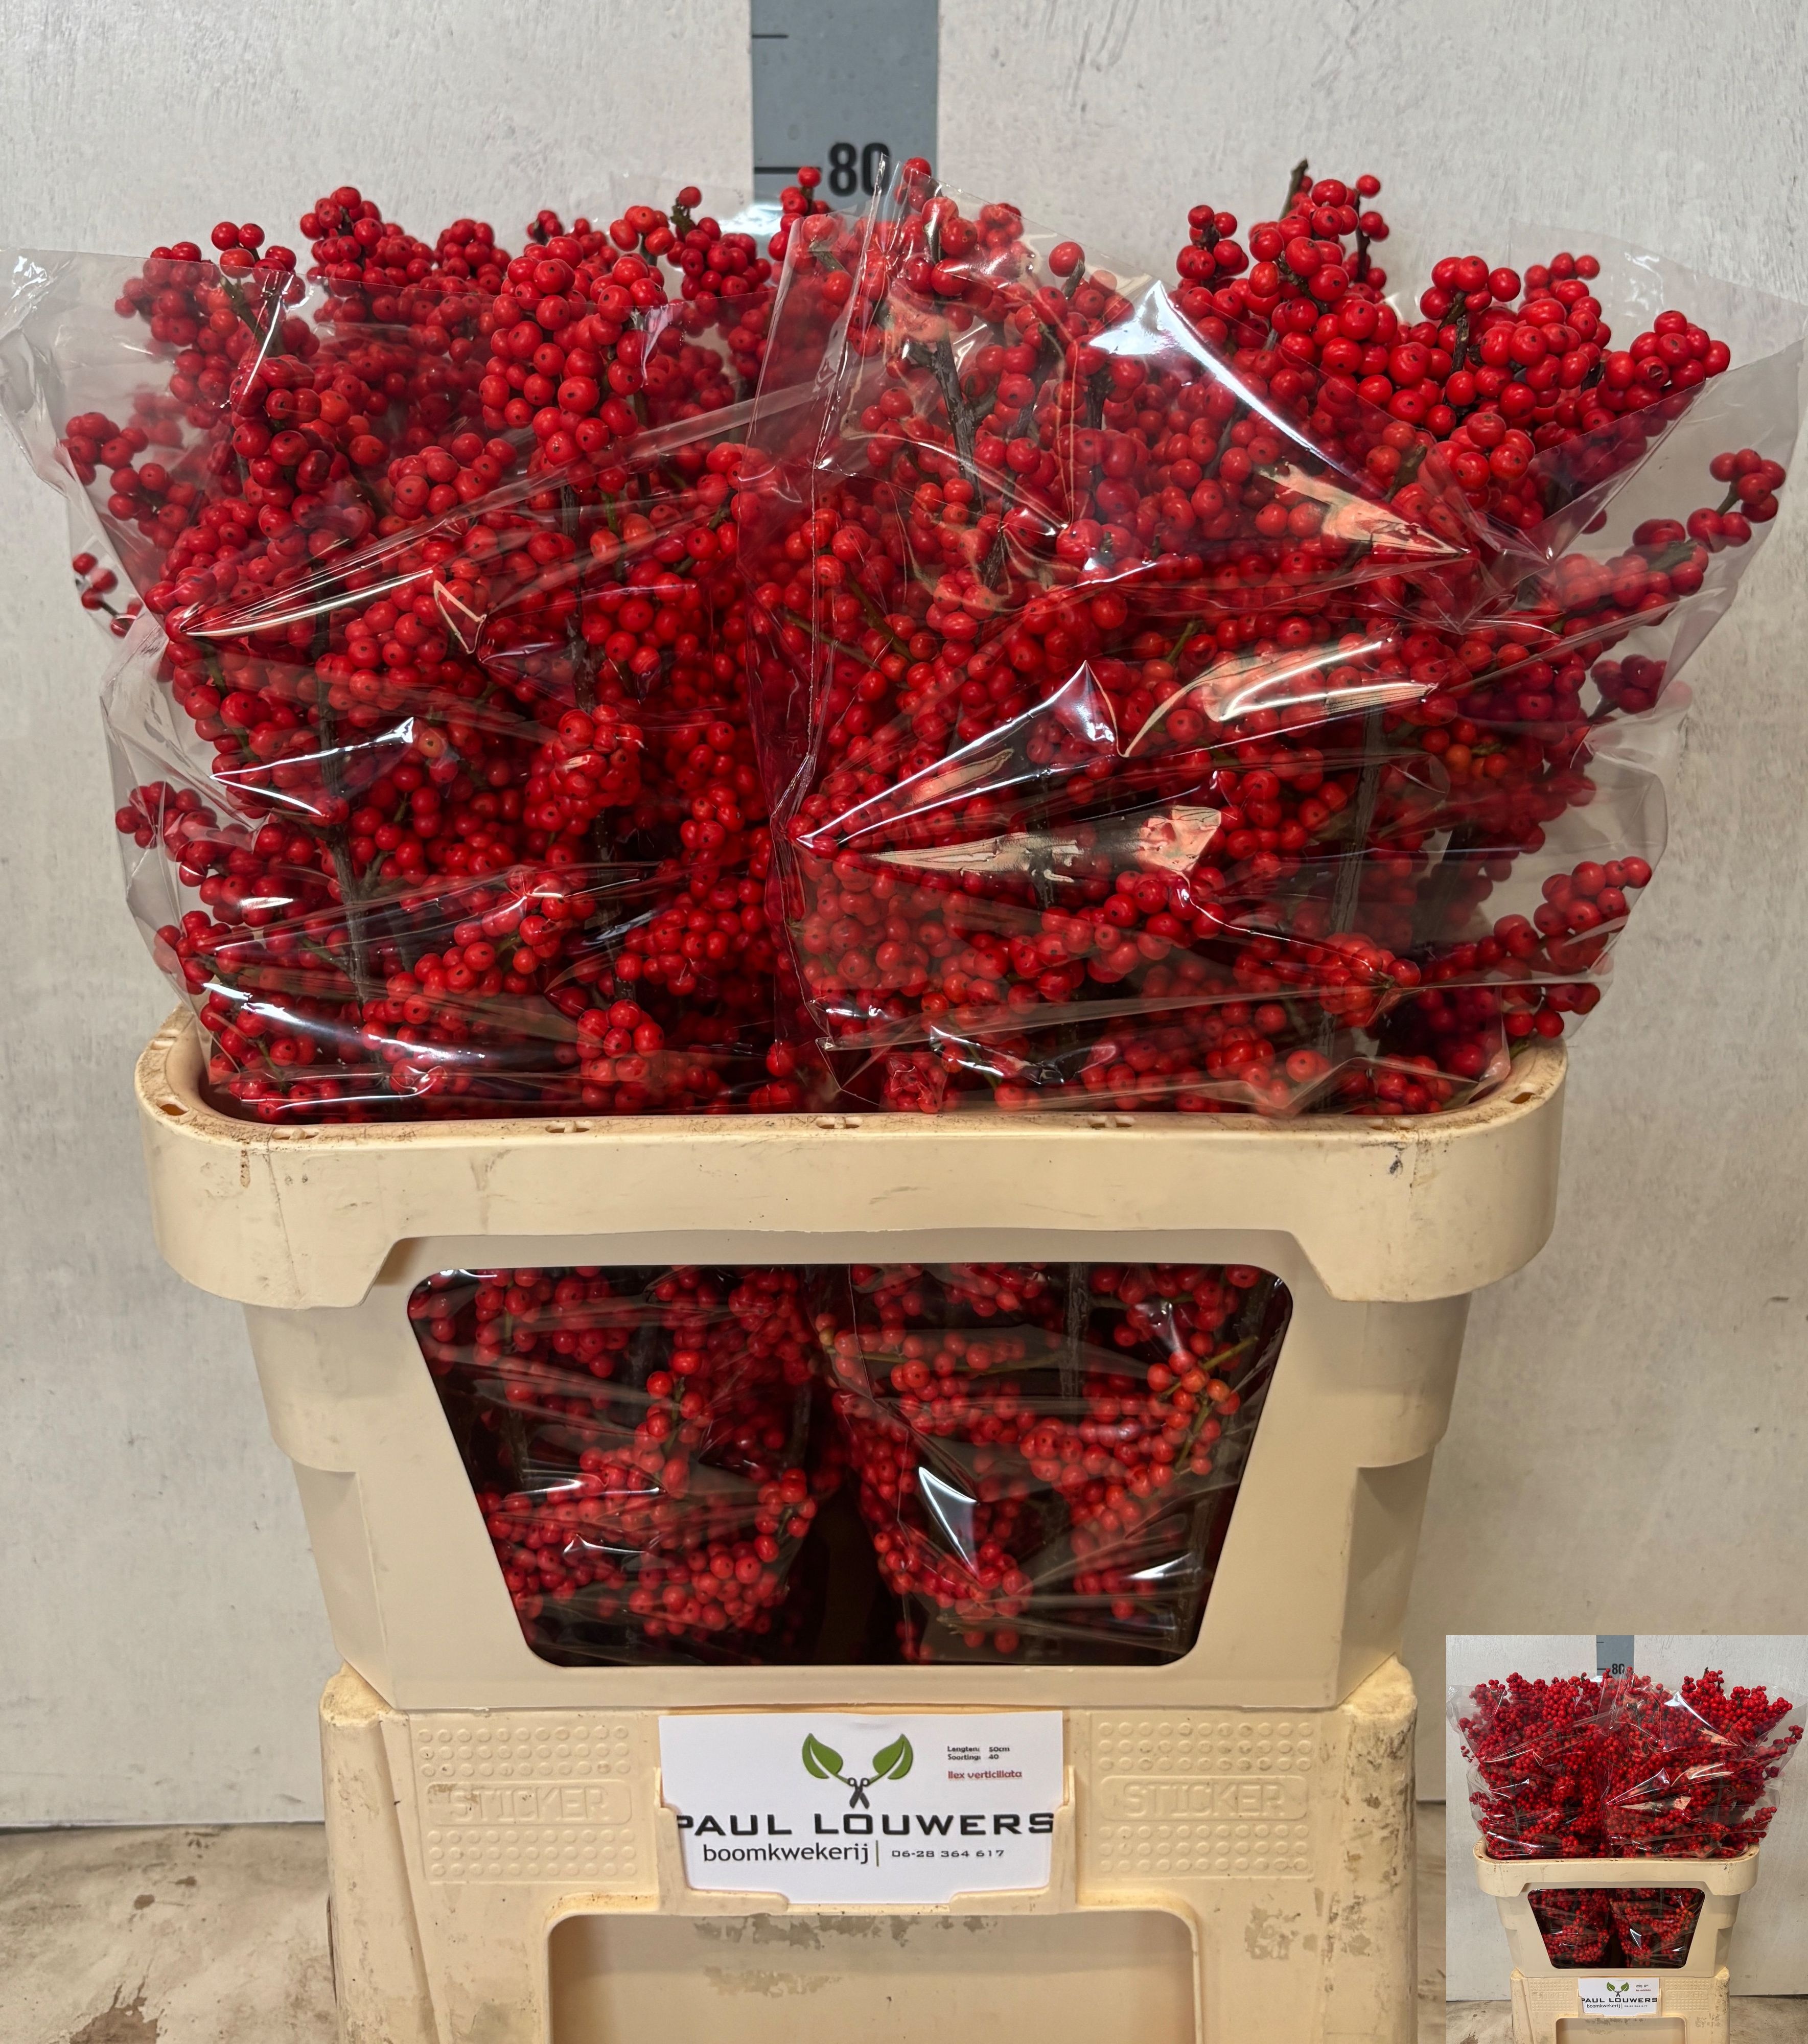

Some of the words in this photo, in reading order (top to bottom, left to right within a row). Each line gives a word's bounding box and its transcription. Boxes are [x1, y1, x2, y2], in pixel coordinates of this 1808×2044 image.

[828, 142, 891, 197] 80
[948, 1770, 965, 1779] Ilex
[967, 1770, 1023, 1779] verticillata
[449, 1785, 611, 1822] STICKER
[1123, 1782, 1285, 1818] STICKER
[676, 1814, 793, 1836] PAUL
[814, 1813, 1054, 1836] LOUWERS
[703, 1842, 869, 1865] boomkwekerij
[891, 1850, 935, 1858] 06-28
